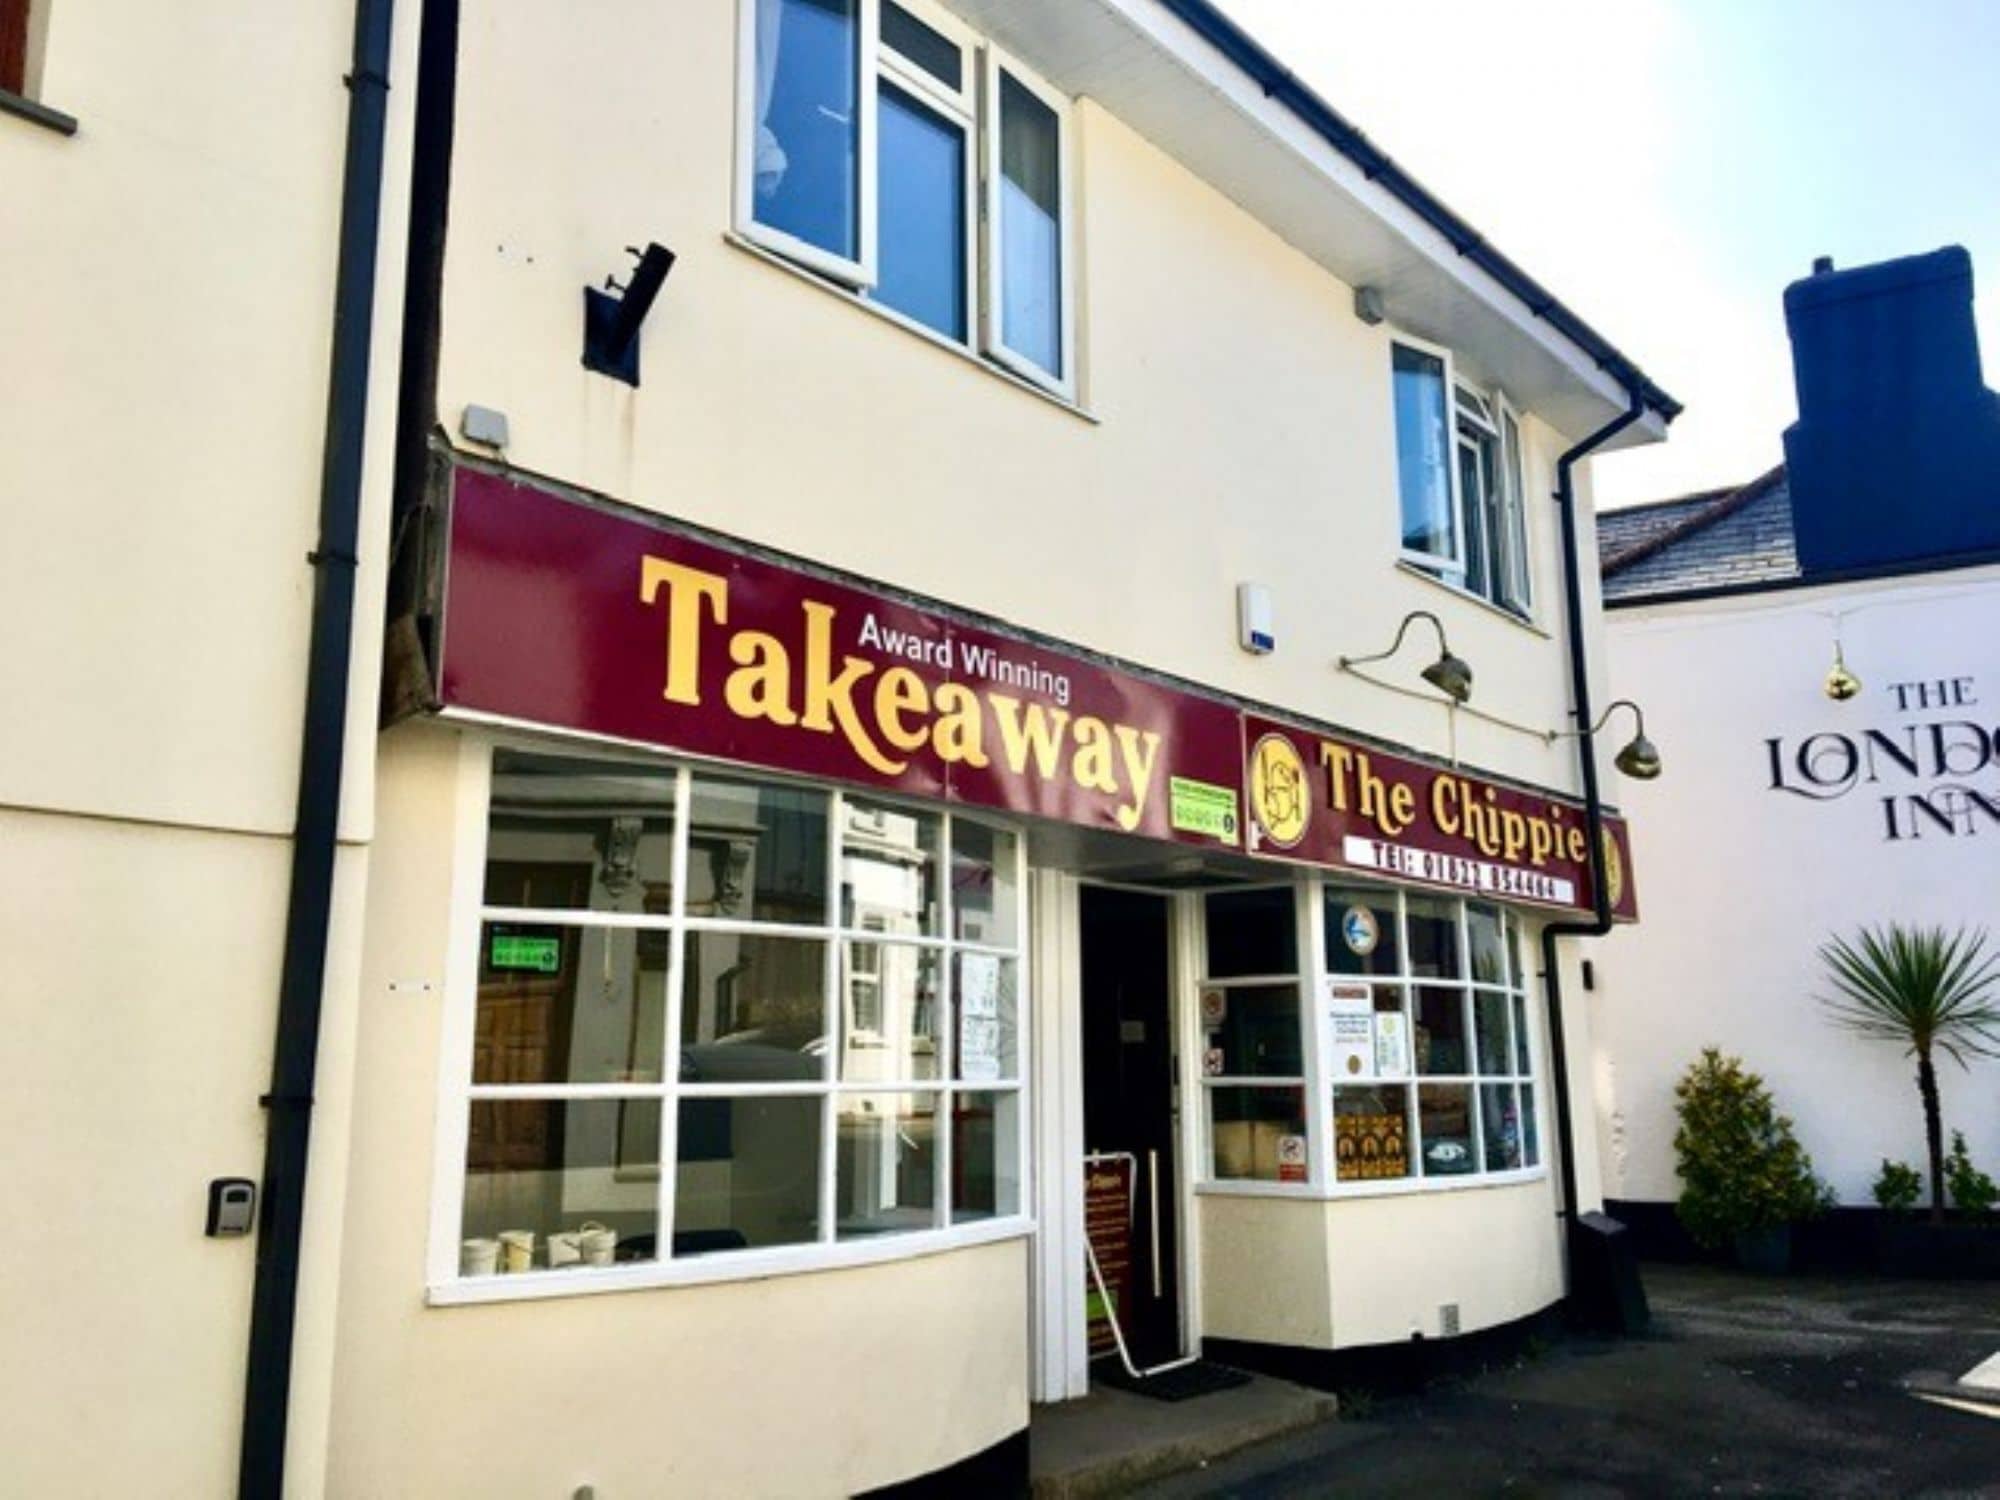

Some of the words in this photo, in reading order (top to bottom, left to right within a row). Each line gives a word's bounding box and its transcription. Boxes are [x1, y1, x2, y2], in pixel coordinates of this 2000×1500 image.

[640, 554, 1161, 831] Takeaway
[858, 613, 953, 669] Award
[960, 642, 1070, 706] Winning
[1887, 676, 1978, 712] THE
[1320, 741, 1416, 836] The
[1432, 773, 1587, 866] Chippie
[1764, 720, 2000, 801] LOND
[1880, 784, 2000, 841] INN
